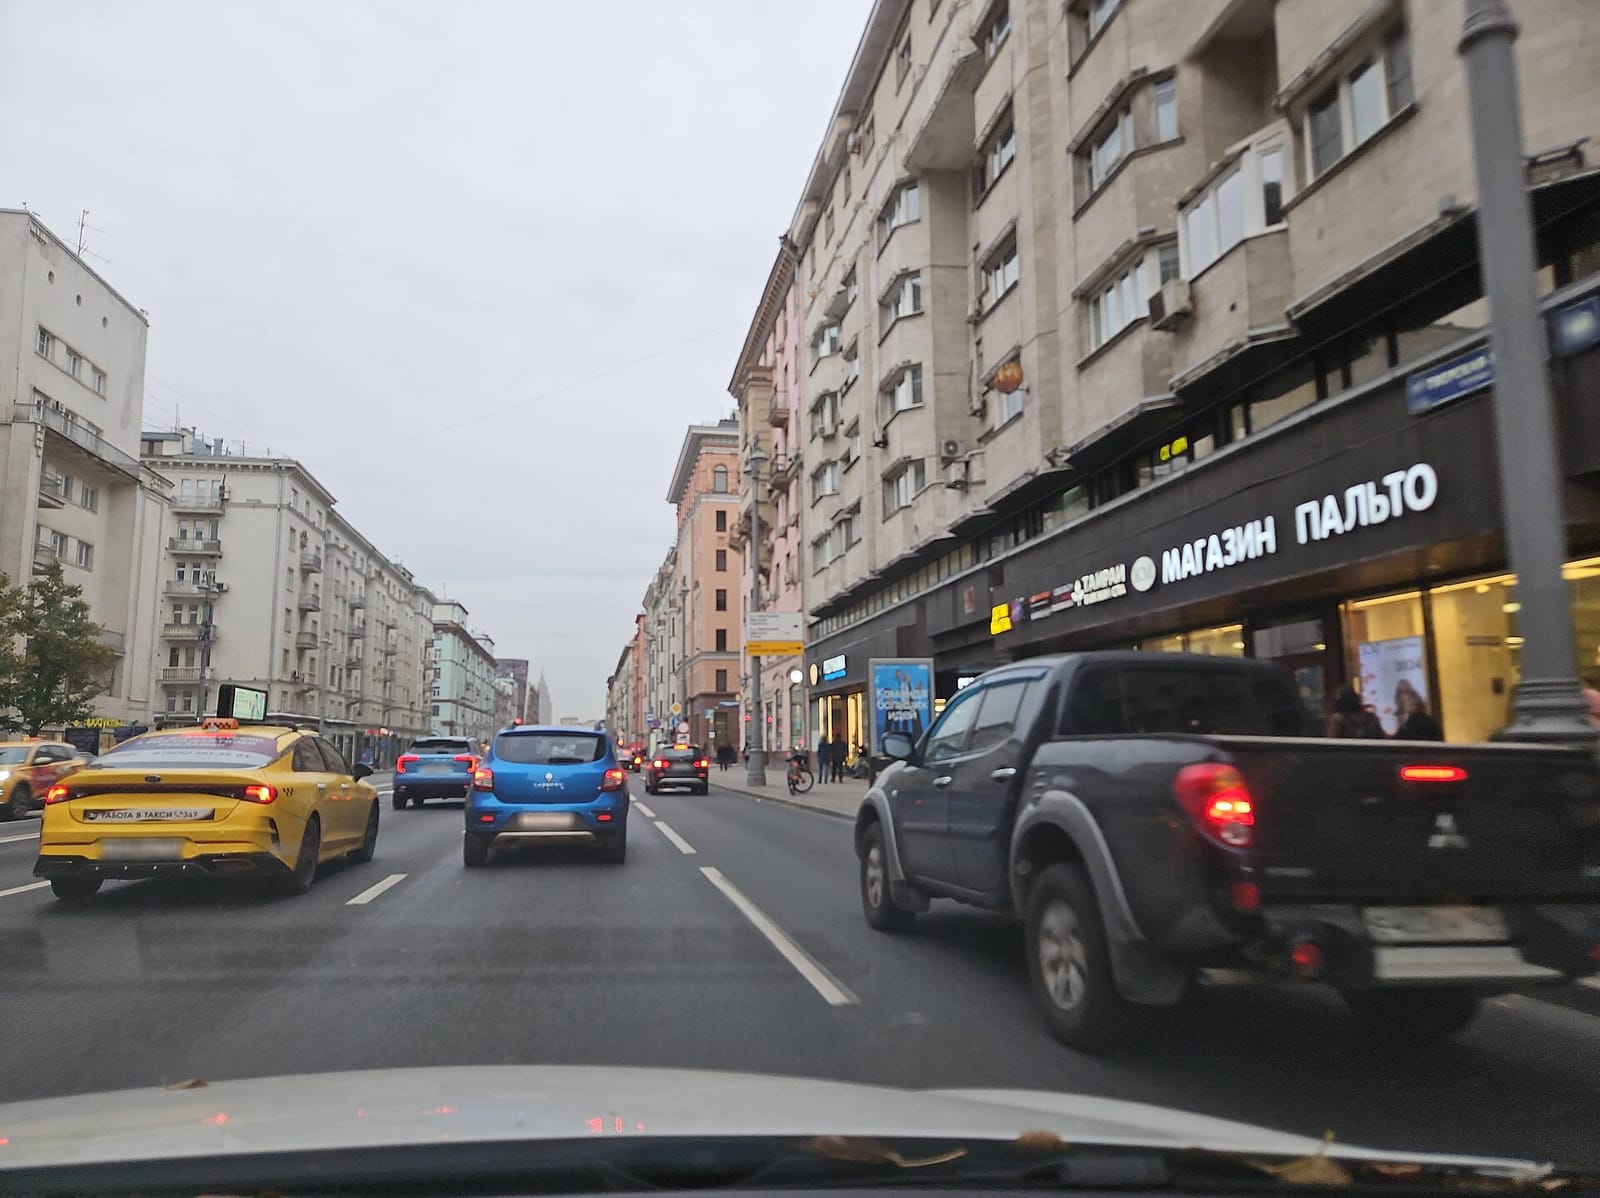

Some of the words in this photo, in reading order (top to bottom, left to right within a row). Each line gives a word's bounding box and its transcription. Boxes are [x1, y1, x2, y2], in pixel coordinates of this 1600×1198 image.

[1161, 515, 1277, 585] МАГАЗИН
[1295, 462, 1438, 545] ПАЛЬТО
[101, 811, 133, 819] РАБОТА
[136, 811, 142, 819] В
[144, 810, 173, 819] ТАКСИ
